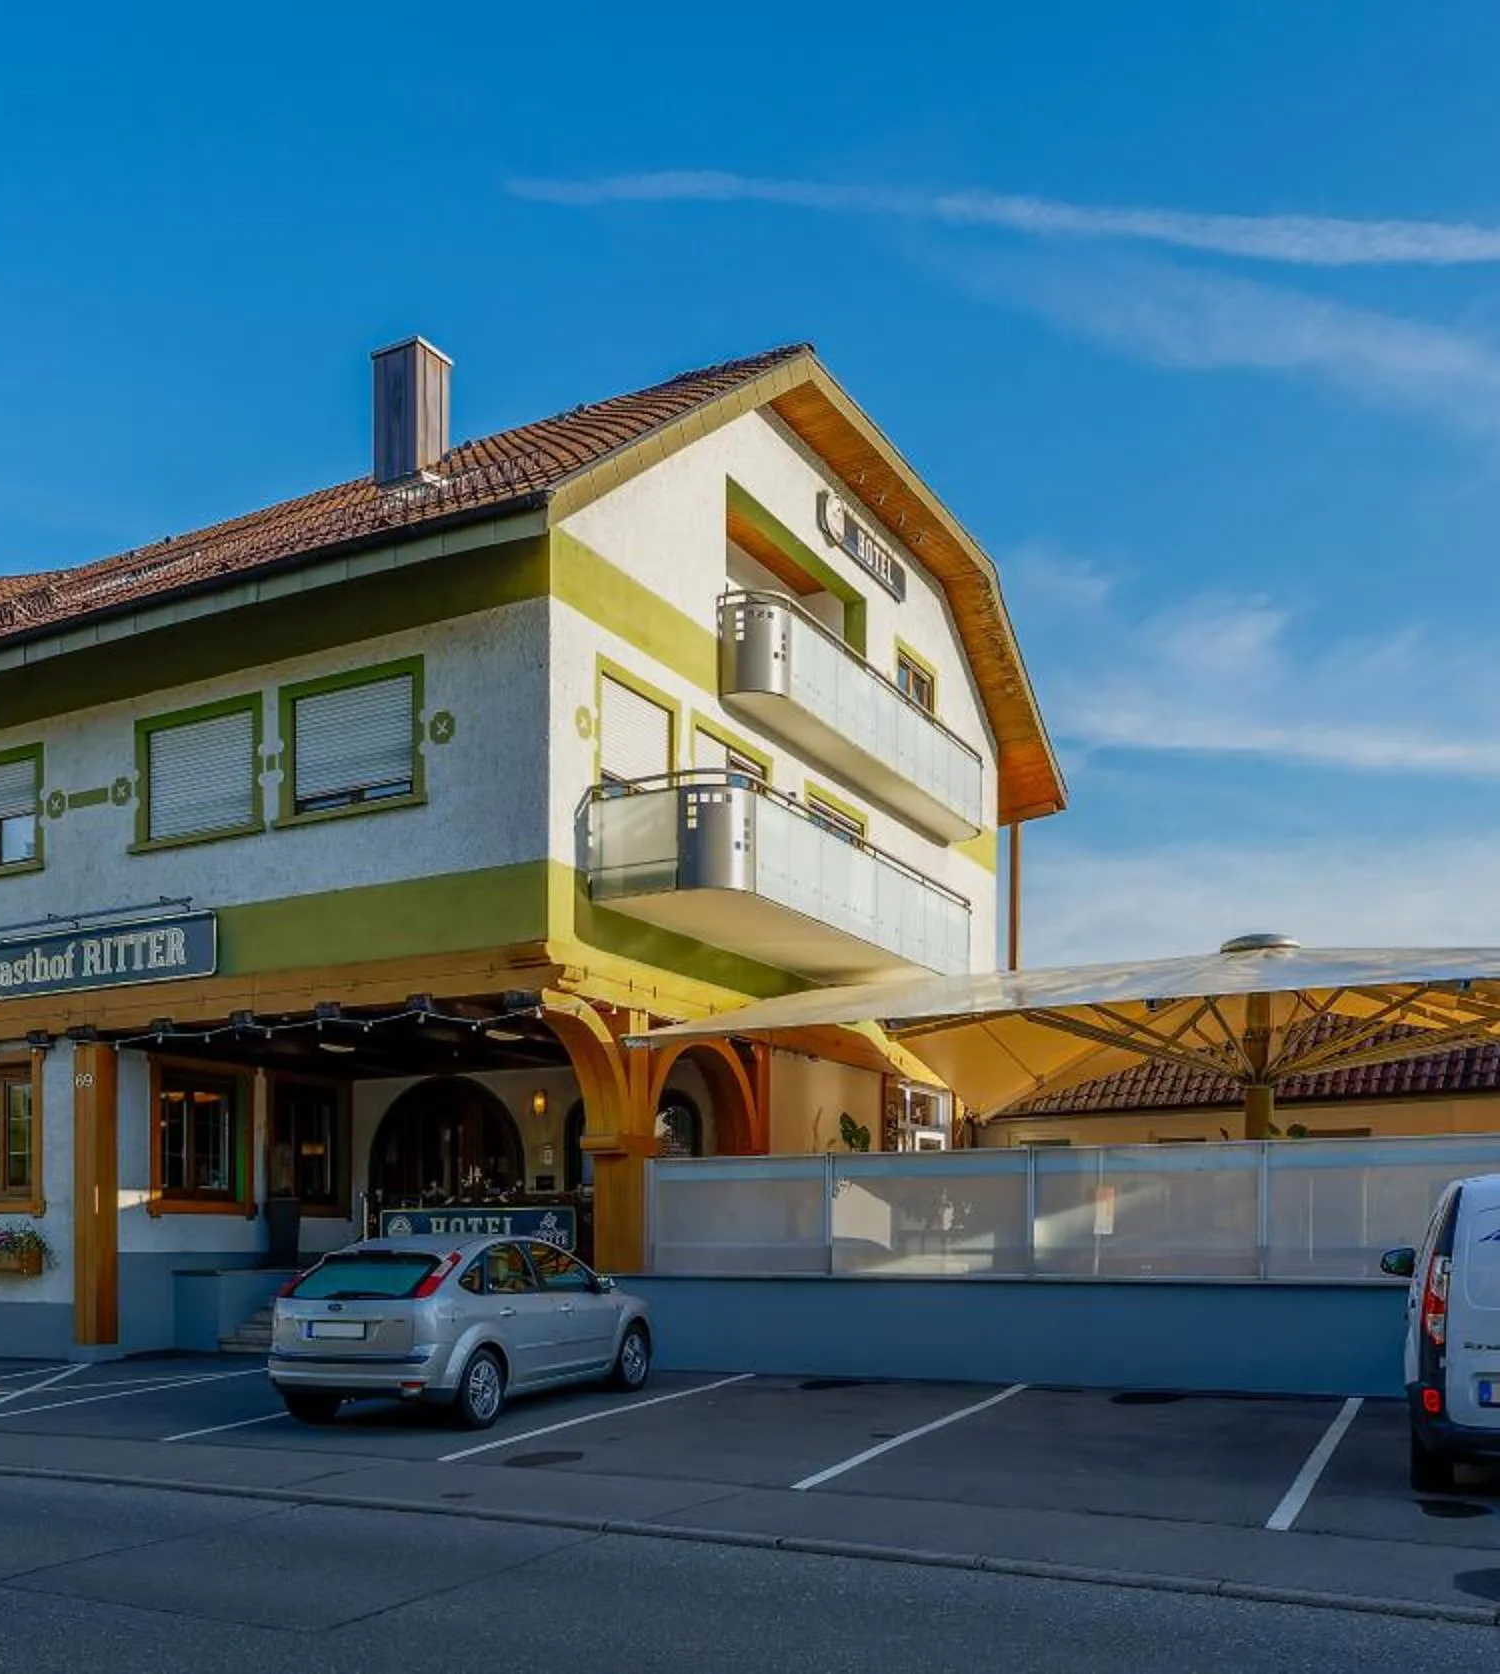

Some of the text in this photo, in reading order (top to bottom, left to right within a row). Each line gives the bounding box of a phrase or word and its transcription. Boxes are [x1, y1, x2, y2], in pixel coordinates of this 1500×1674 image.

[857, 529, 893, 585] HOTEL
[82, 927, 186, 977] RITTER
[75, 1073, 93, 1087] 69
[429, 1217, 513, 1235] HOTEL
